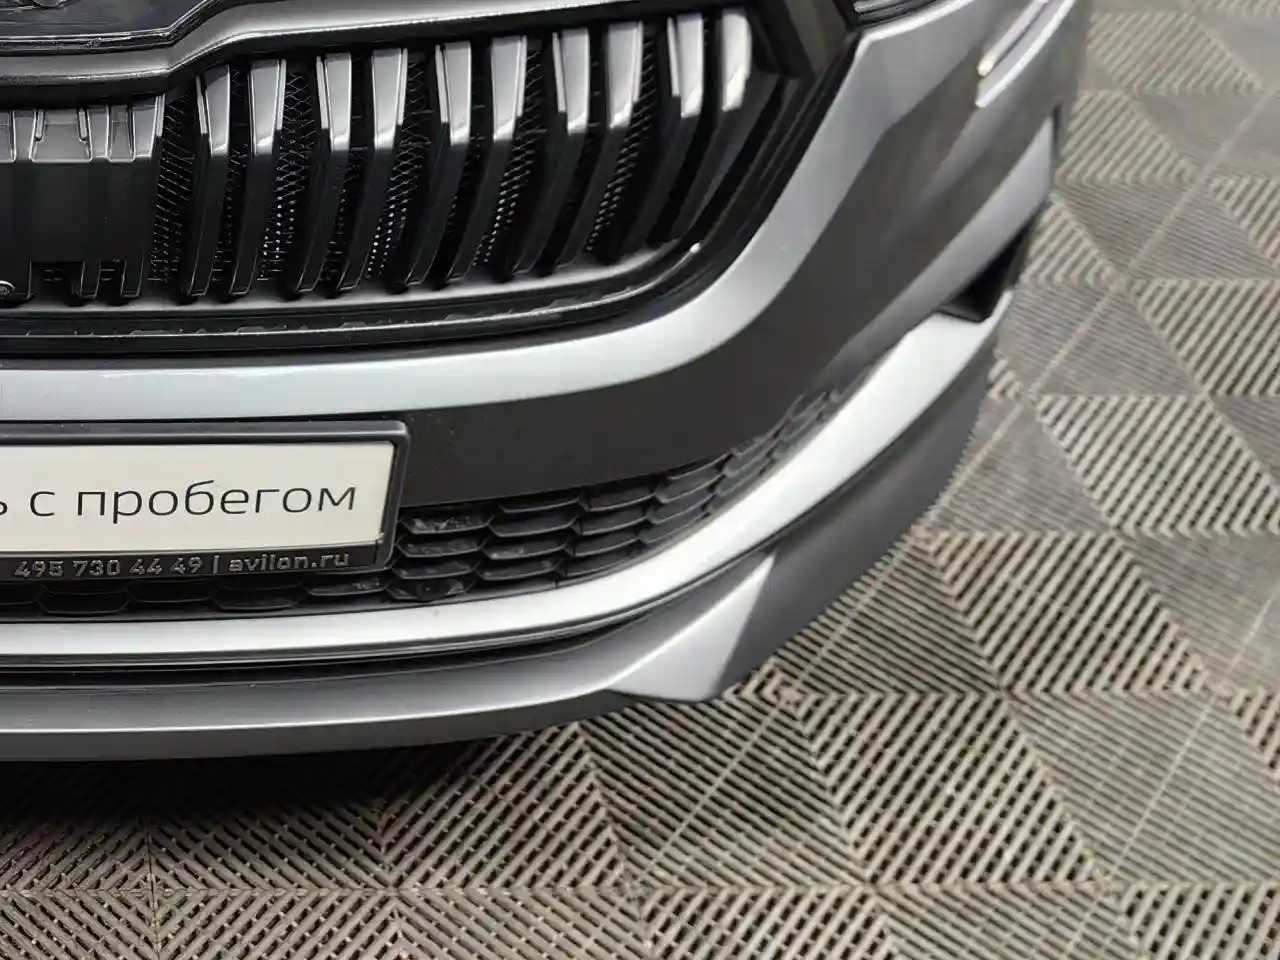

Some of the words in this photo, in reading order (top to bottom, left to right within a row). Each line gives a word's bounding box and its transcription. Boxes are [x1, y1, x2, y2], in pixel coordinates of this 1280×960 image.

[29, 489, 56, 517] с
[76, 479, 356, 524] пробегом
[14, 559, 65, 578] 495
[73, 559, 120, 578] 730
[130, 557, 163, 576] 44
[171, 555, 204, 575] 49
[227, 552, 349, 572] avilon.ru
